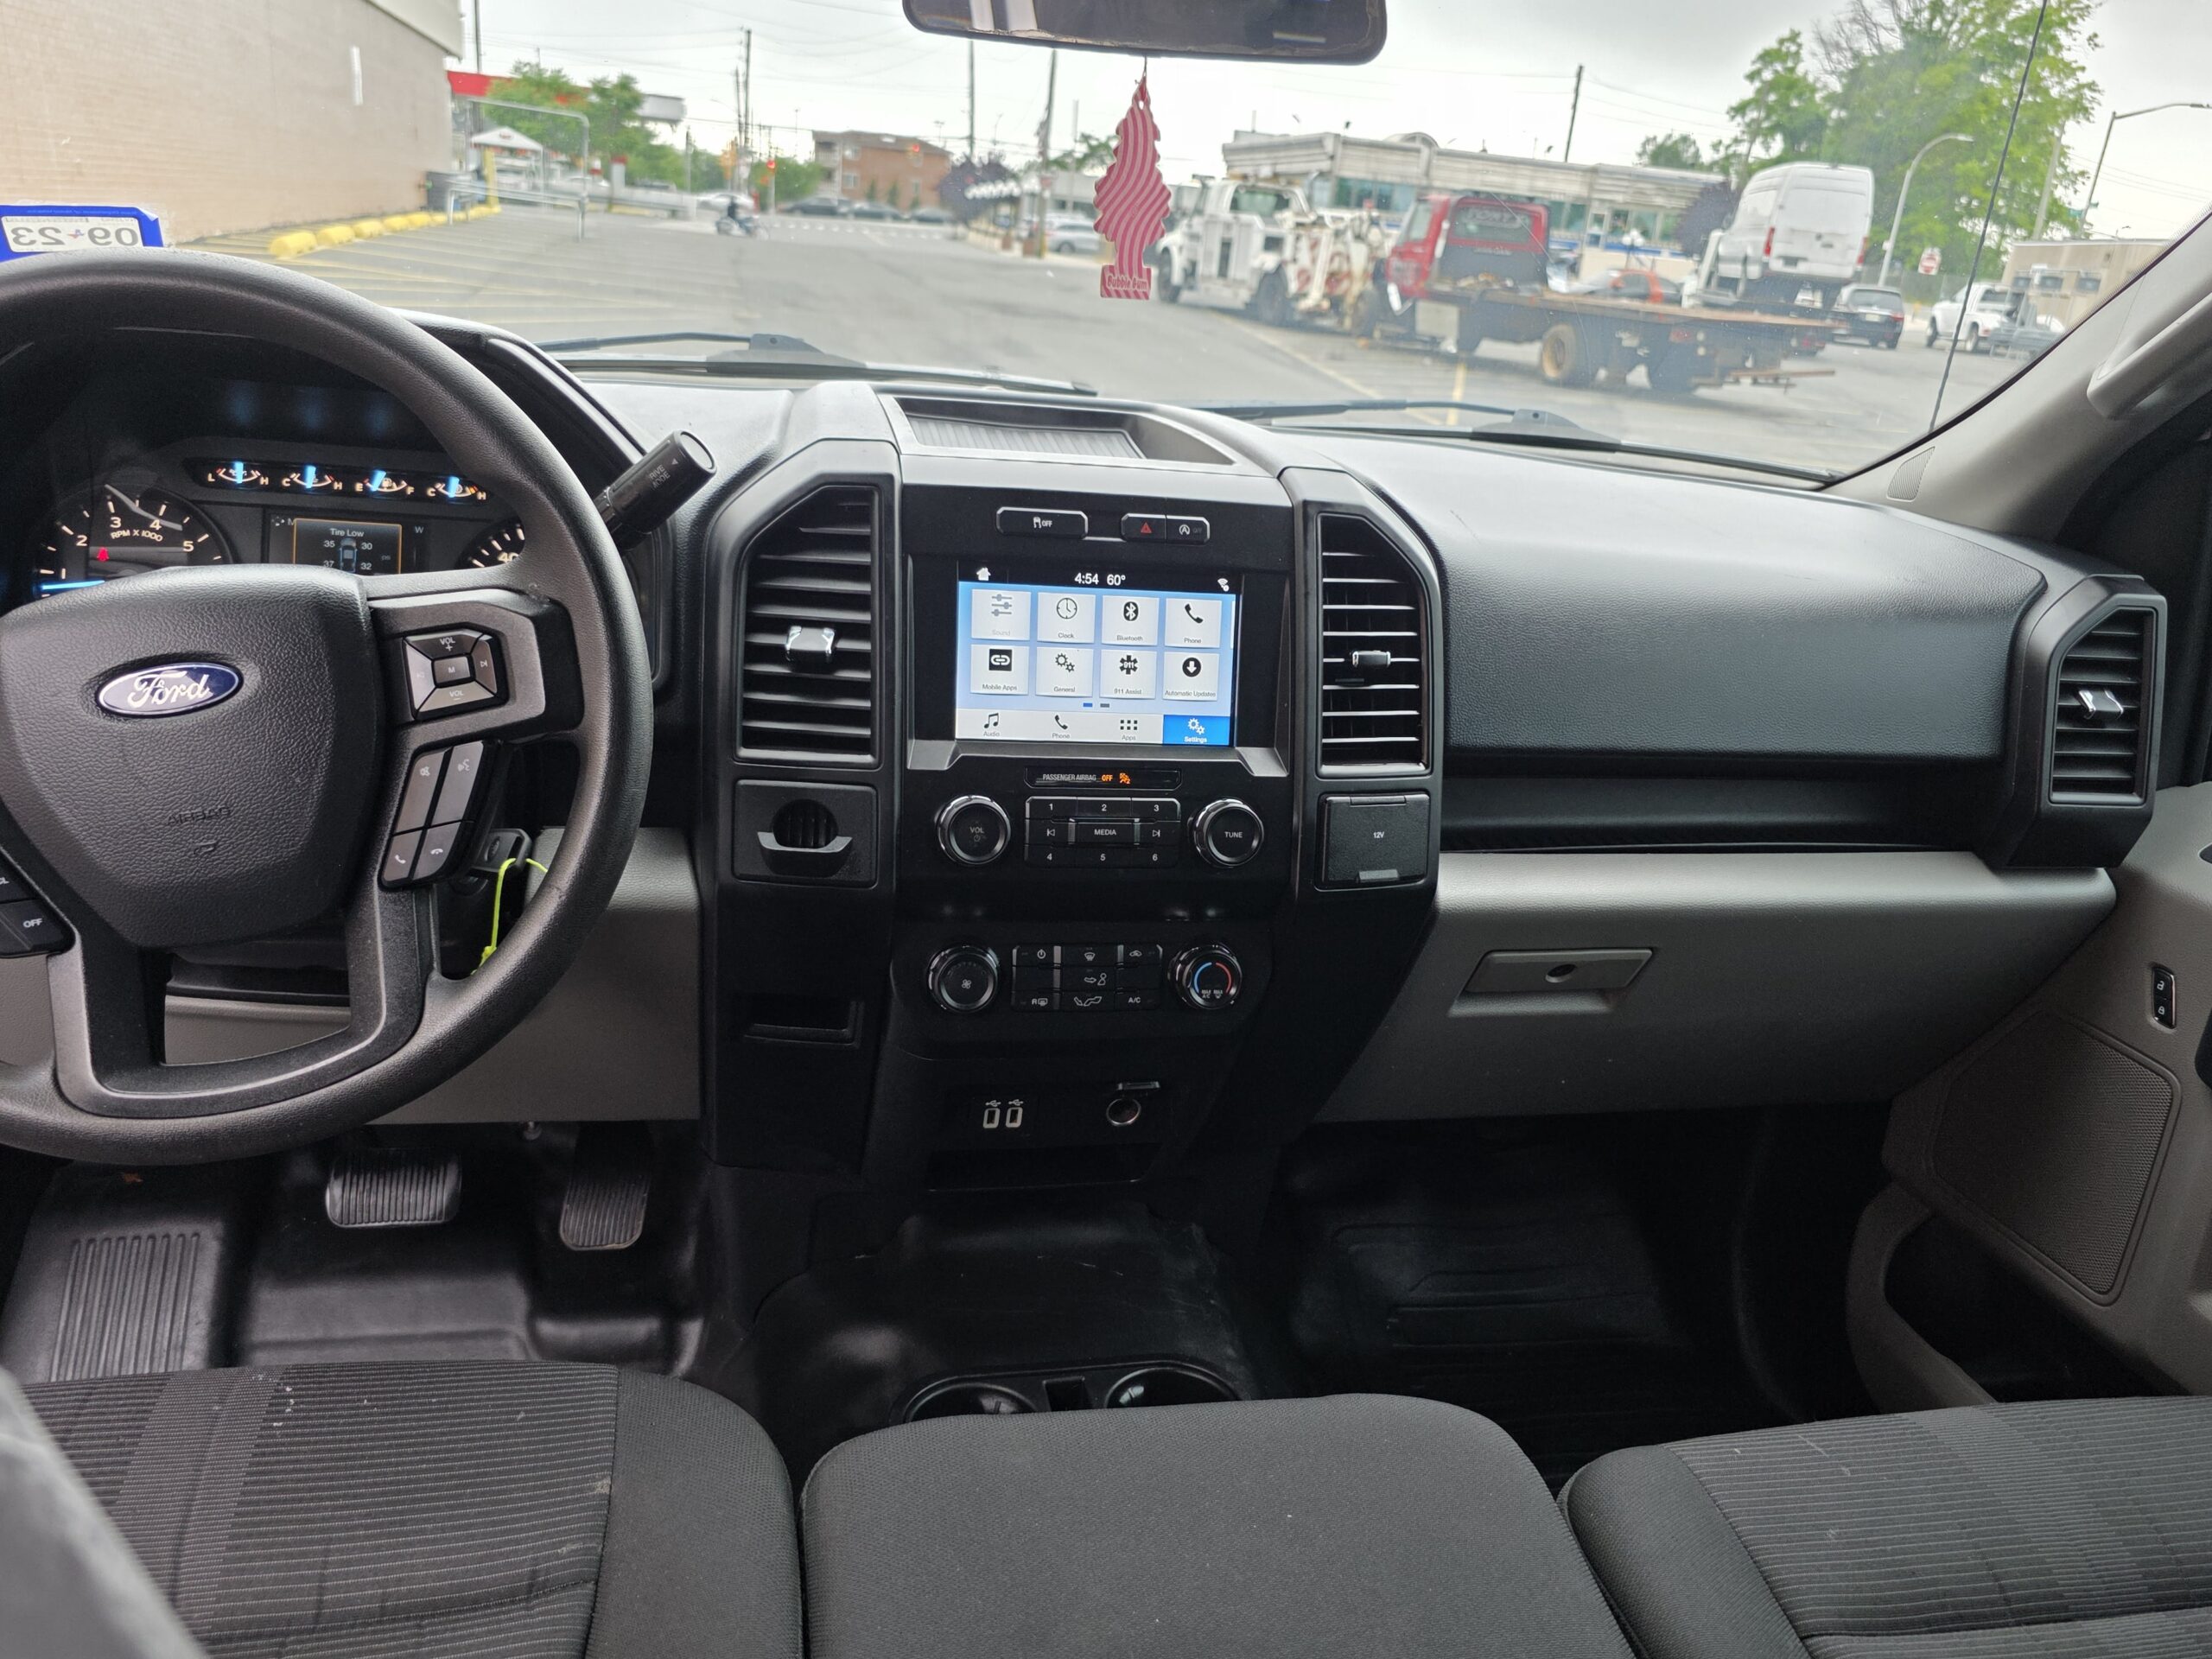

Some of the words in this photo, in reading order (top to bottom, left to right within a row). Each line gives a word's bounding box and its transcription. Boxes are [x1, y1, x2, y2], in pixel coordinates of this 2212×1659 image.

[207, 474, 215, 482] L
[260, 476, 269, 486] H
[282, 477, 290, 487] C
[334, 481, 343, 491] H
[355, 482, 363, 492] E
[427, 487, 436, 497] C
[477, 491, 486, 500] H
[110, 517, 122, 528] 3
[149, 518, 162, 531] 4
[1041, 519, 1052, 528] OFF
[111, 529, 130, 540] RPM
[141, 529, 163, 542] 1000
[330, 528, 345, 537] Tire
[346, 529, 365, 538] Low
[76, 535, 88, 546] 2
[182, 540, 194, 552] 5
[1074, 572, 1099, 585] 4:54
[1107, 574, 1126, 586] 60°
[439, 636, 455, 645] VOL
[127, 671, 210, 707] Ford
[1184, 736, 1208, 745] Settings
[1042, 773, 1076, 782] PASSENGER
[1101, 773, 1114, 782] OFF
[1048, 804, 1053, 812] 1
[1101, 804, 1107, 812] 2
[1154, 804, 1160, 812] 3
[969, 826, 985, 835] VOL
[1094, 828, 1117, 836] MEDIA
[1046, 853, 1052, 861] 4
[1100, 853, 1106, 861] 5
[1152, 853, 1158, 861] 6
[22, 918, 43, 929] OFF
